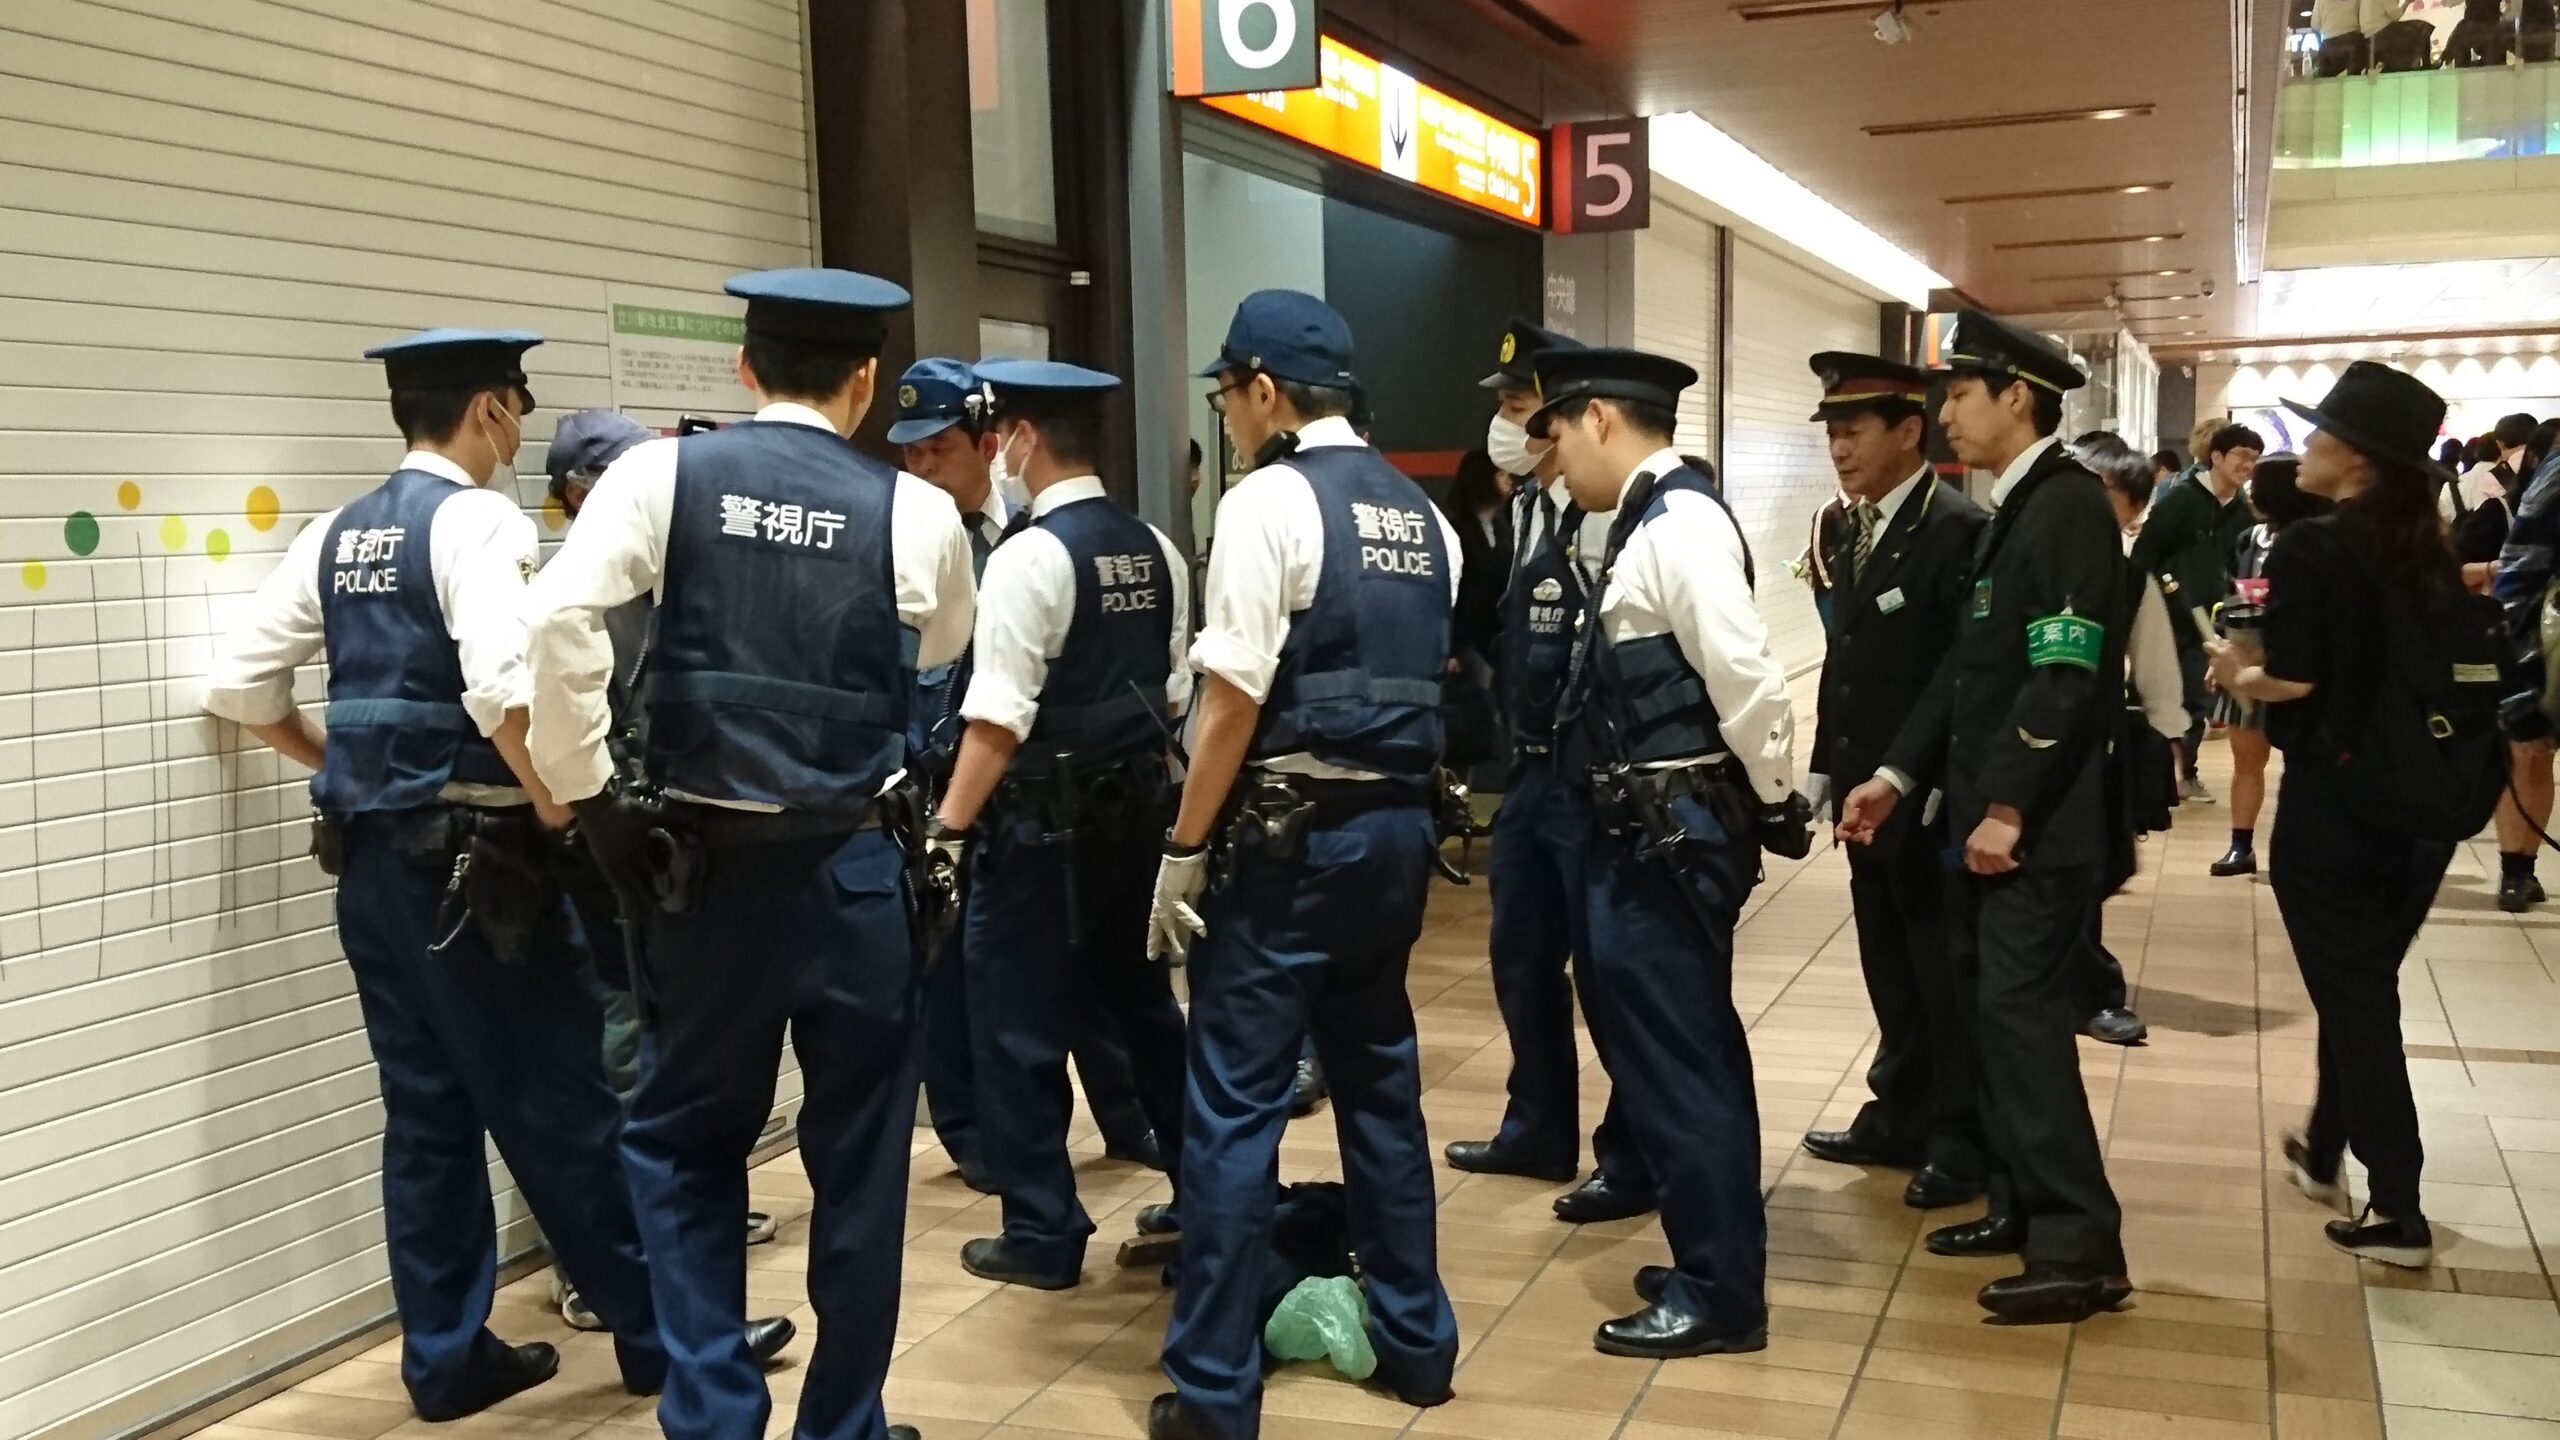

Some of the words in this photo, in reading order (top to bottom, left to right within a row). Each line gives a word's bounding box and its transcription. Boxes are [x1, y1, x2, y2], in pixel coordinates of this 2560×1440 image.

[1219, 0, 1296, 69] 6
[1522, 144, 1536, 218] 5
[1586, 132, 1633, 217] 5
[720, 493, 847, 549] 警視庁
[1350, 502, 1426, 545] 警視庁
[335, 525, 405, 564] 警視庁
[1361, 545, 1433, 576] POLICE
[334, 567, 397, 595] POLICE
[1093, 553, 1153, 586] 警視庁
[1101, 589, 1157, 613] POLICE
